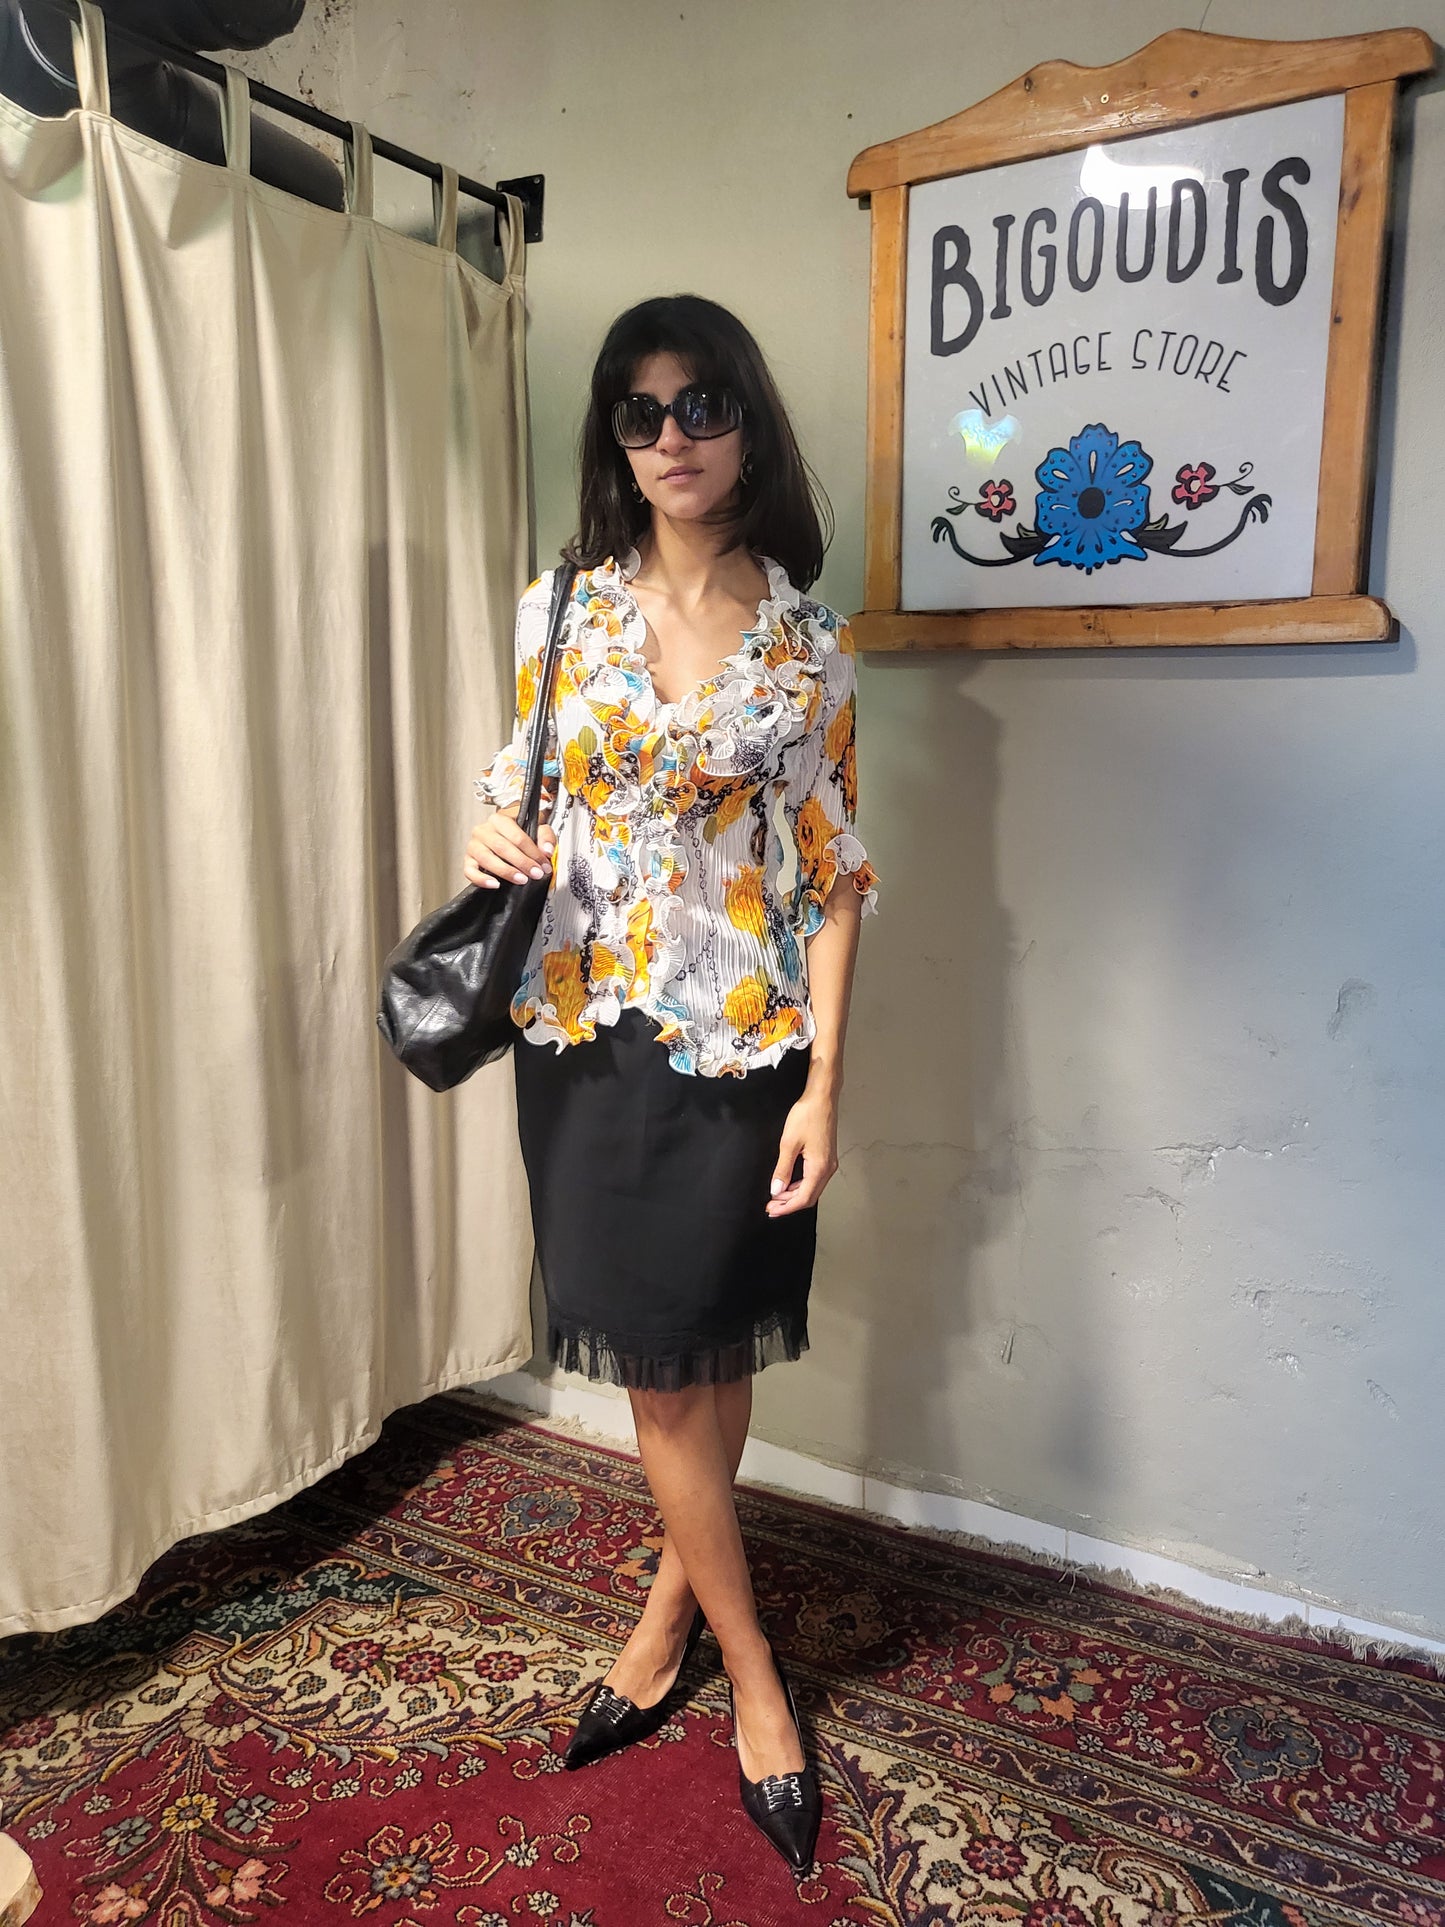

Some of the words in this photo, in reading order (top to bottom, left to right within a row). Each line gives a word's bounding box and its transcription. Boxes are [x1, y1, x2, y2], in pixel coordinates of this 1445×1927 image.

[930, 157, 1310, 357] BIGOUDIS
[969, 331, 1112, 416] VINTAGE
[1131, 328, 1247, 393] STORE
